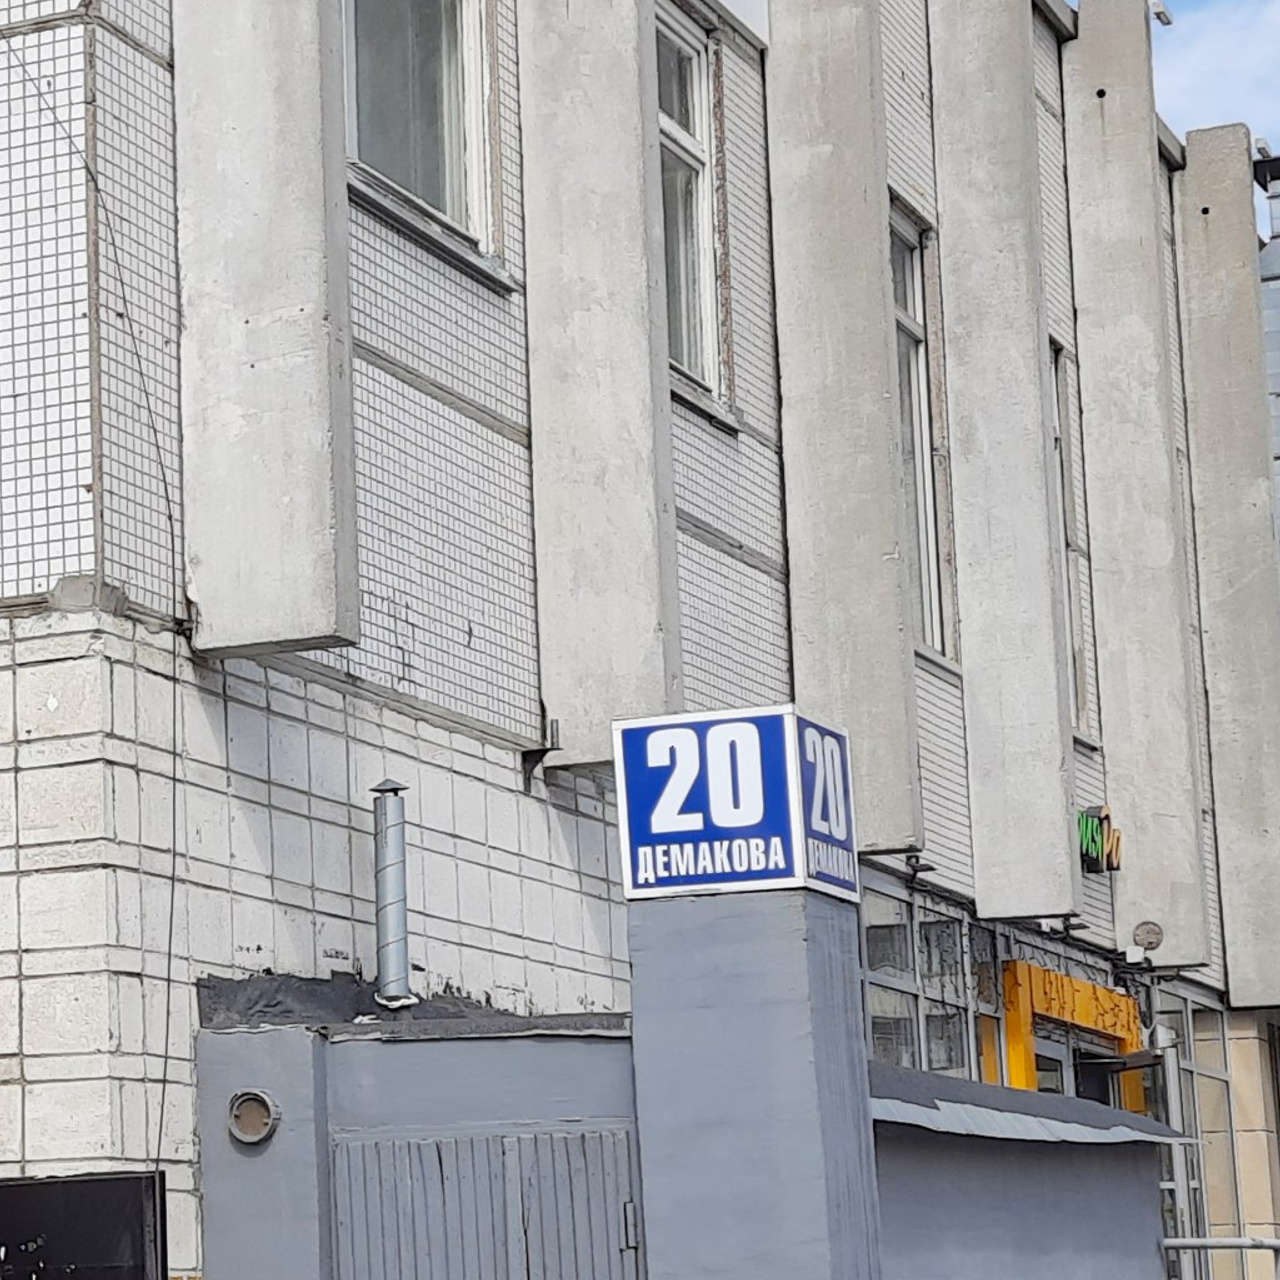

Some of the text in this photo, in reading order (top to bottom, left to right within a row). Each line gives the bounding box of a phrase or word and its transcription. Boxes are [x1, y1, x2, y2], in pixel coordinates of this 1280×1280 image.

[646, 722, 764, 834] 20
[804, 727, 848, 842] 20
[637, 836, 786, 884] ДЕМАКОВА
